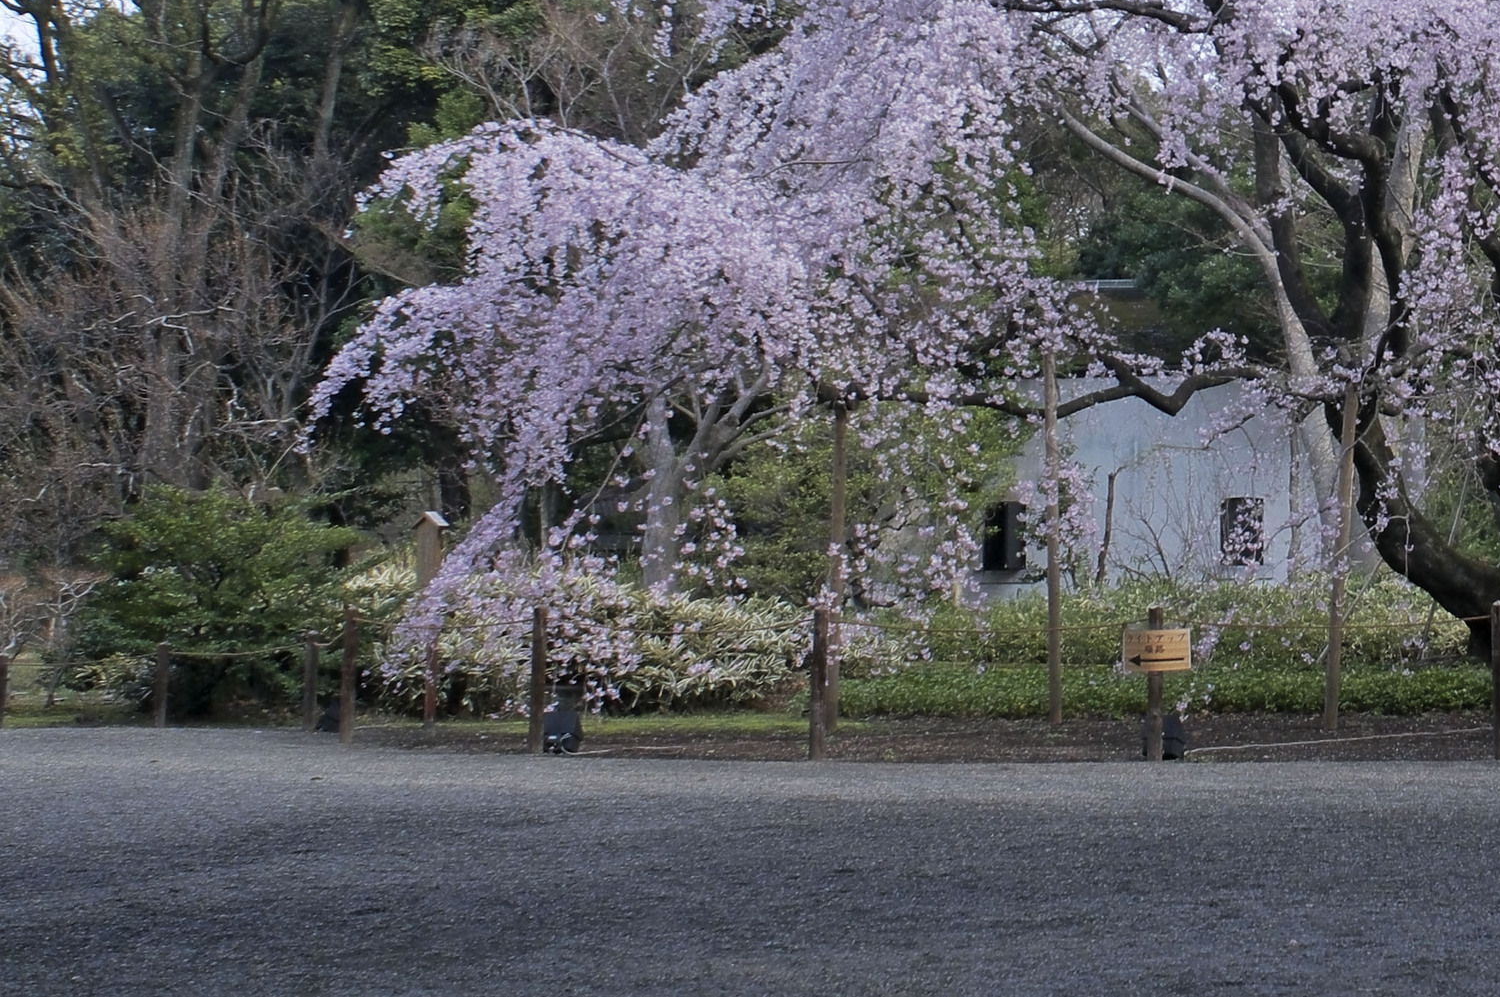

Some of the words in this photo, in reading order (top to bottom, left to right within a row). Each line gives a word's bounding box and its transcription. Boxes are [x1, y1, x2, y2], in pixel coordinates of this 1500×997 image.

[1127, 633, 1186, 643] ライトアップ
